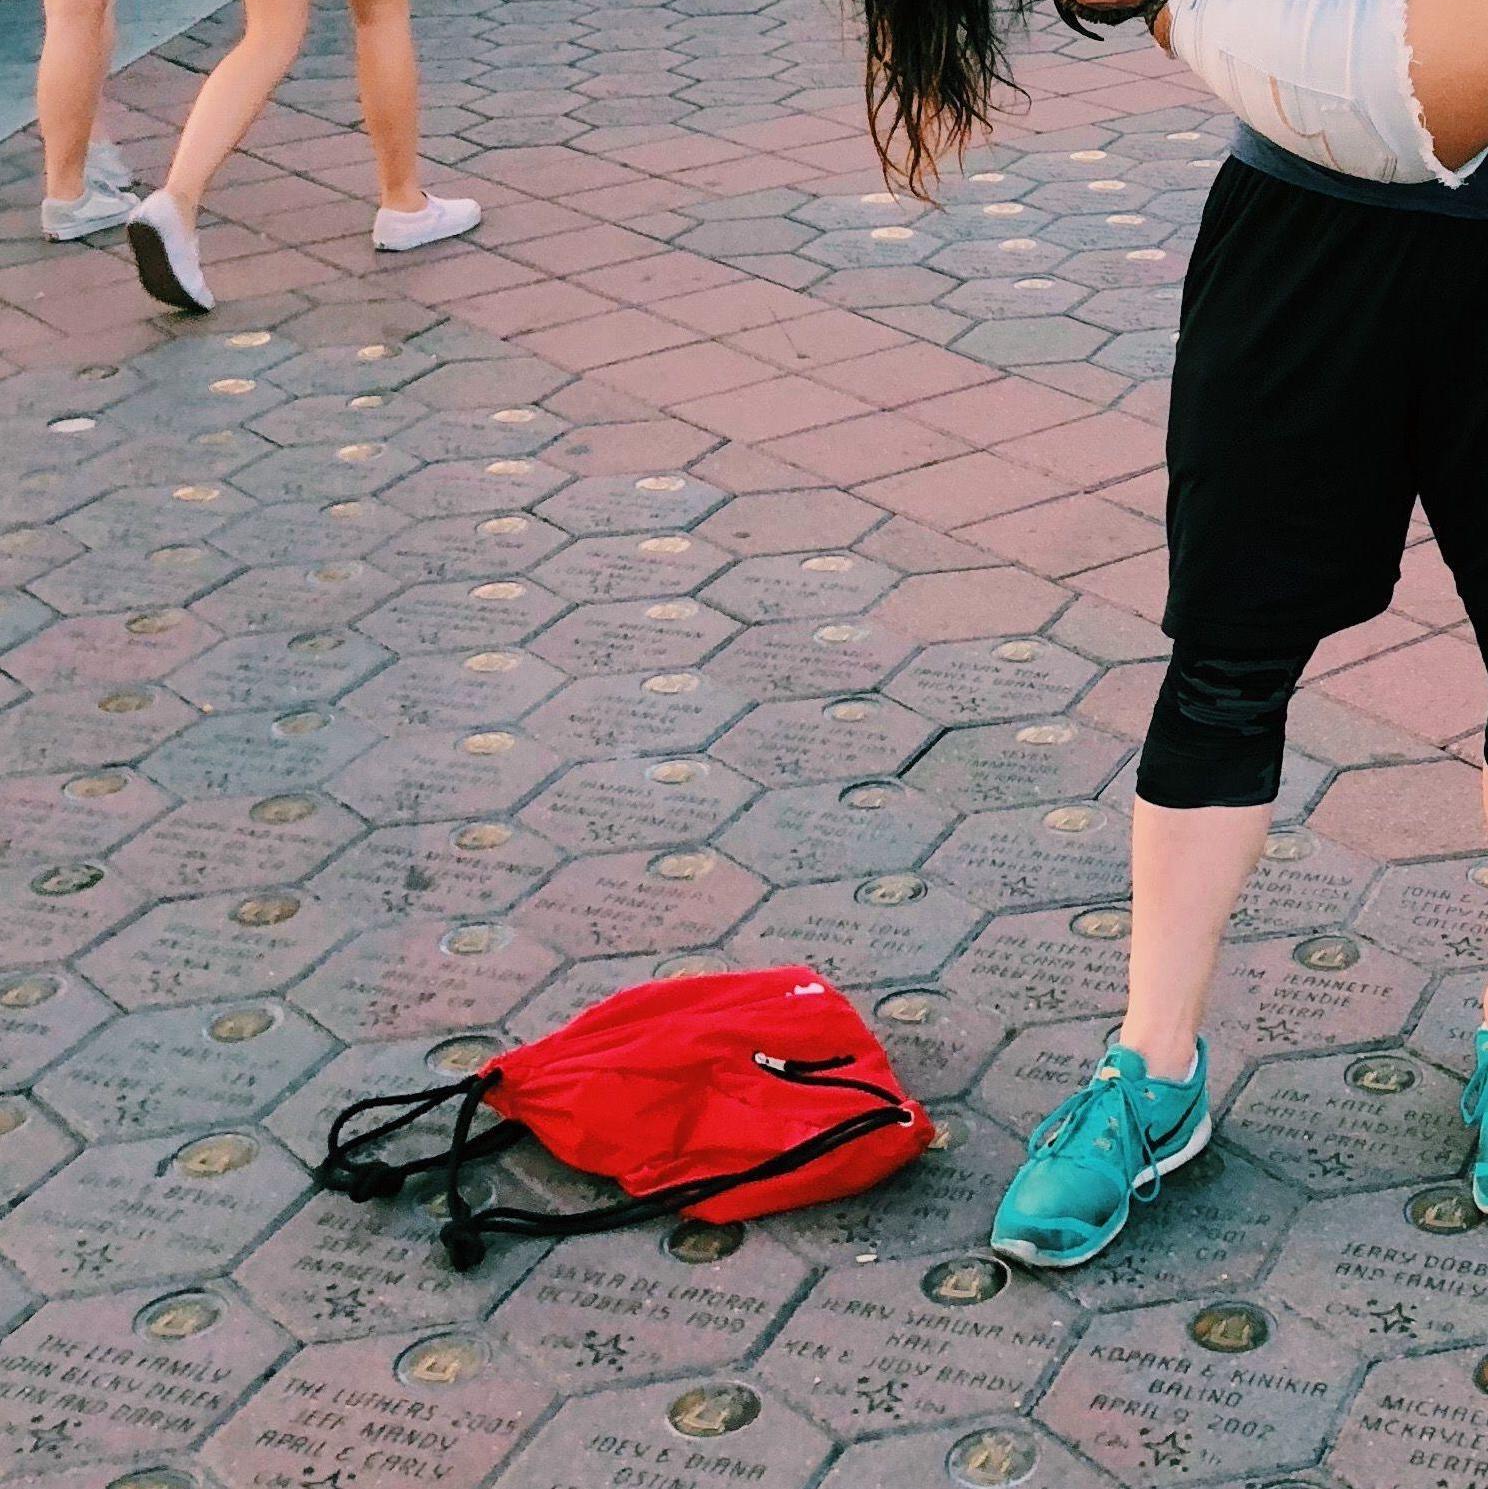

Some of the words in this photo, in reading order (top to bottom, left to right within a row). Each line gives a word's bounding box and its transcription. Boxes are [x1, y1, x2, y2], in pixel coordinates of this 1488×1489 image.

[1231, 968, 1265, 981] JIM
[1340, 1243, 1418, 1265] JERRY
[1335, 1263, 1385, 1281] AND
[1393, 1271, 1488, 1298] FAMILY
[905, 1310, 1004, 1338] SHAUNA
[784, 1338, 830, 1361] KEN
[864, 1356, 933, 1376] JUDY
[284, 1377, 326, 1400] THE
[335, 1387, 439, 1422] LUTHERS
[1089, 1393, 1159, 1420] APRIL
[256, 1429, 324, 1460] APRIL
[289, 1408, 347, 1431] JEFF
[360, 1420, 460, 1453] MANDY
